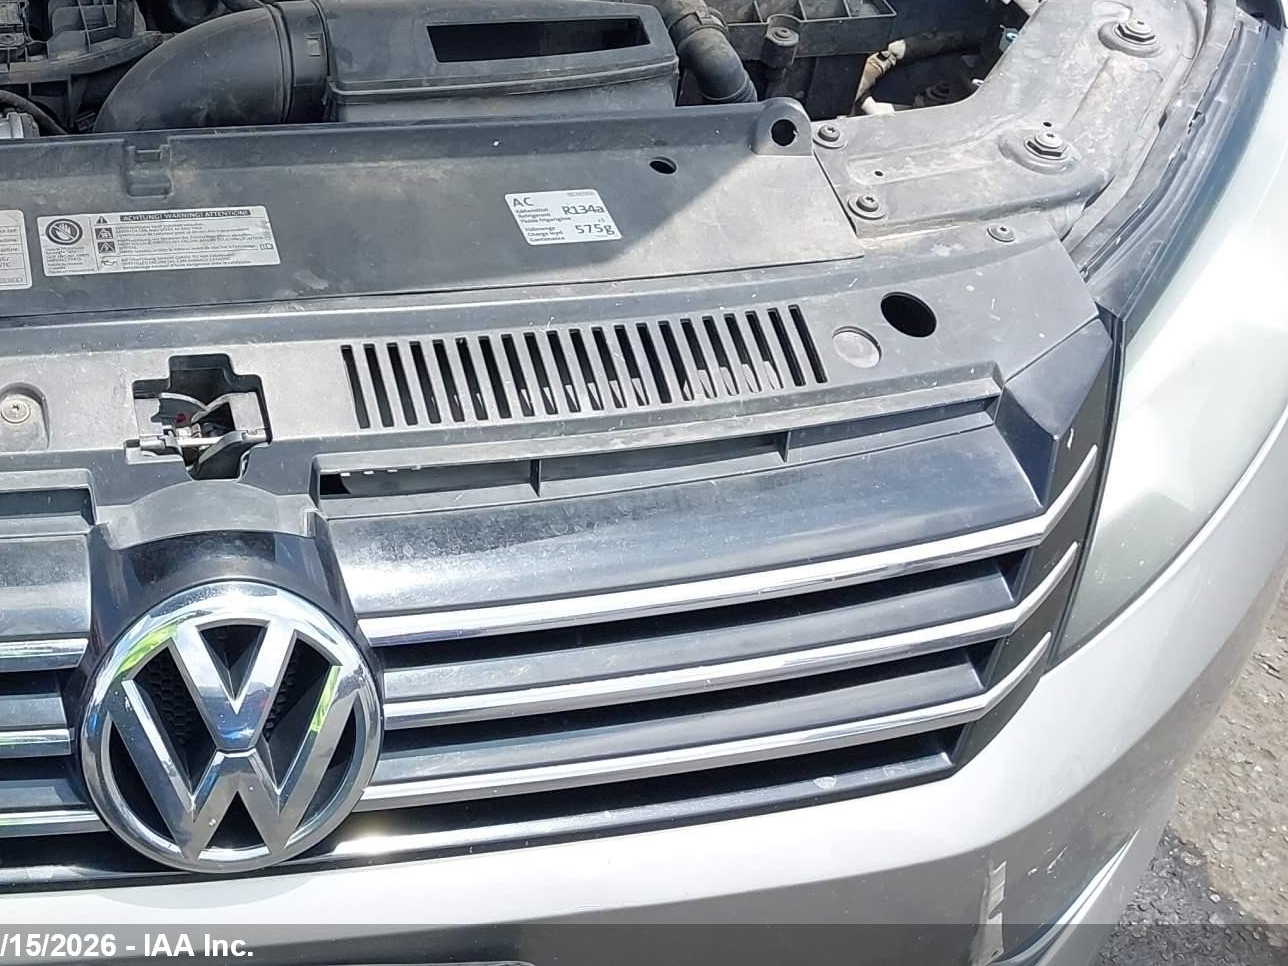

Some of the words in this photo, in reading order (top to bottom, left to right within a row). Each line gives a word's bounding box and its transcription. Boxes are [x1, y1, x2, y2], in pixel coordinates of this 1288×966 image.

[513, 197, 534, 207] AC
[562, 205, 605, 215] R134a
[164, 212, 204, 220] WARNING!
[575, 224, 615, 235] 575g
